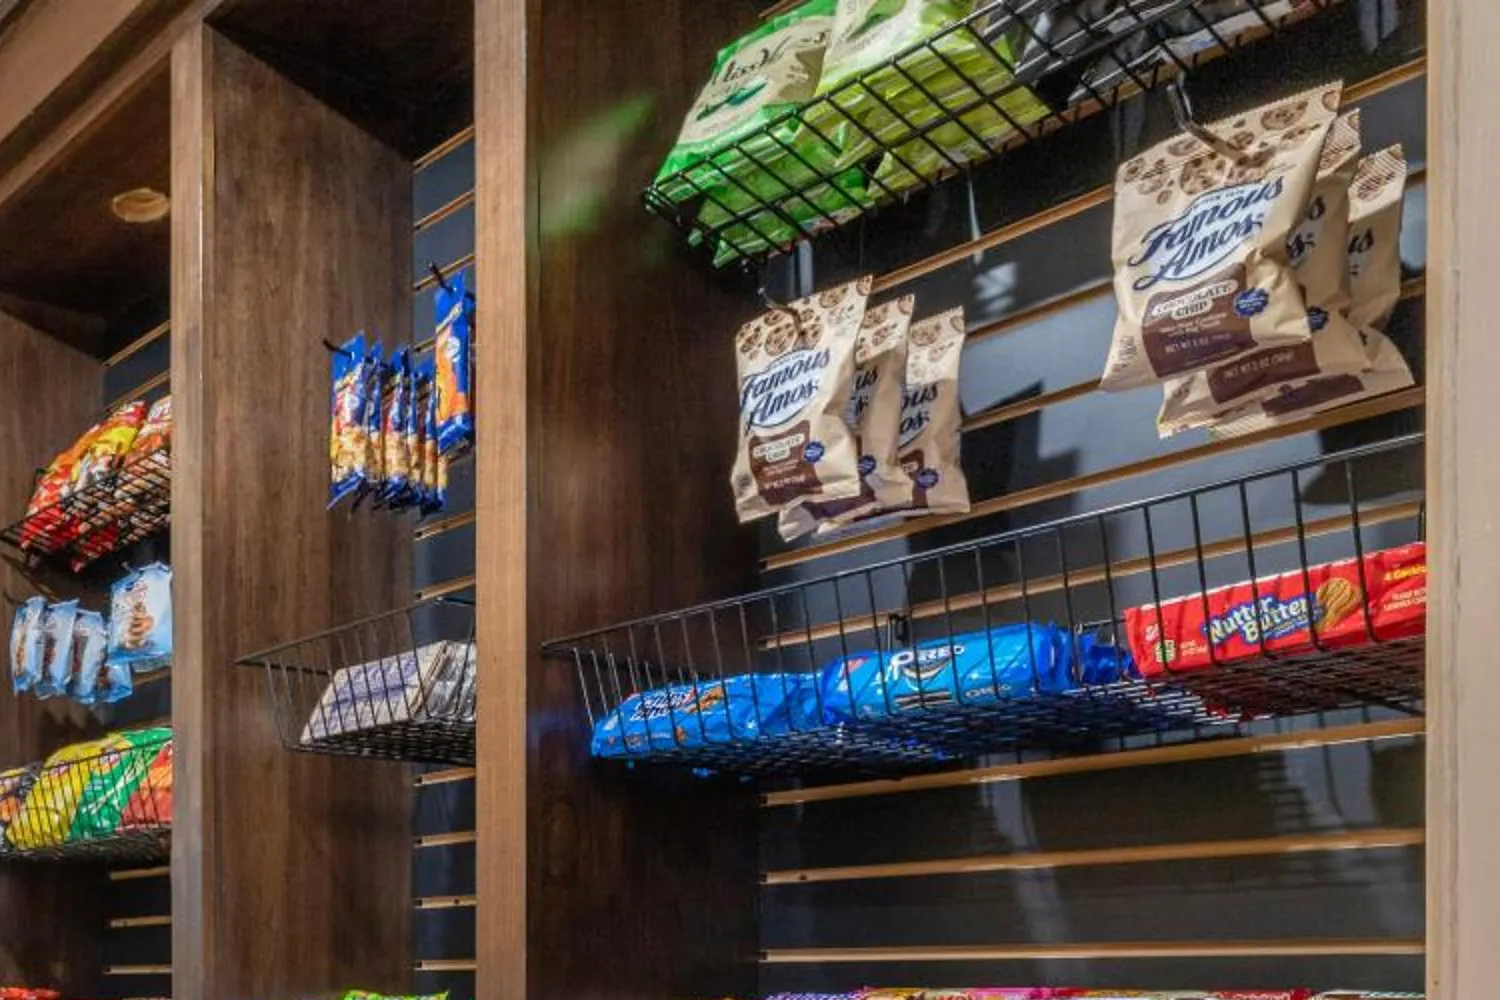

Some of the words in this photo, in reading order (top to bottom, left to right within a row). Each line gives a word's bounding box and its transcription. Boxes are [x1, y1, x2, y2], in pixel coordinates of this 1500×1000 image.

[1127, 175, 1283, 266] Famous
[1133, 214, 1255, 291] Amos
[740, 349, 830, 412] Famous
[745, 382, 815, 437] Amos
[1210, 597, 1273, 643] Nuttr
[891, 644, 965, 667] OREO
